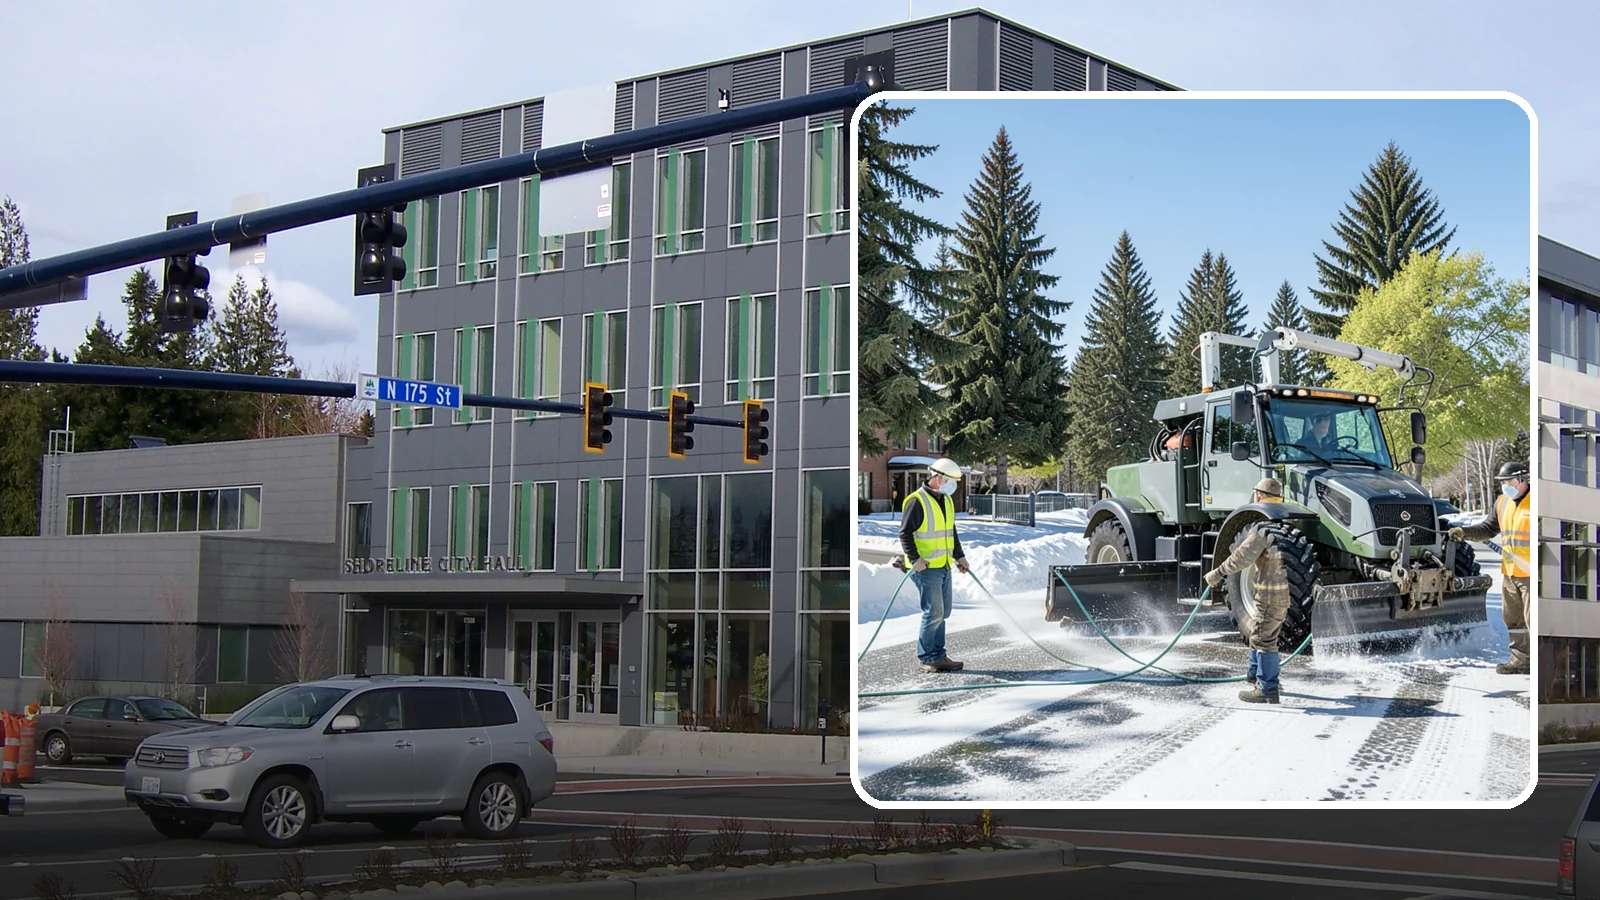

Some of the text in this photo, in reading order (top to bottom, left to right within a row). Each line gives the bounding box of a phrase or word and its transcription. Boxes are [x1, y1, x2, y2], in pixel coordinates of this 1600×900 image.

[387, 380, 451, 405] N 175 St
[344, 556, 525, 574] SHORELINE CITY HALL
